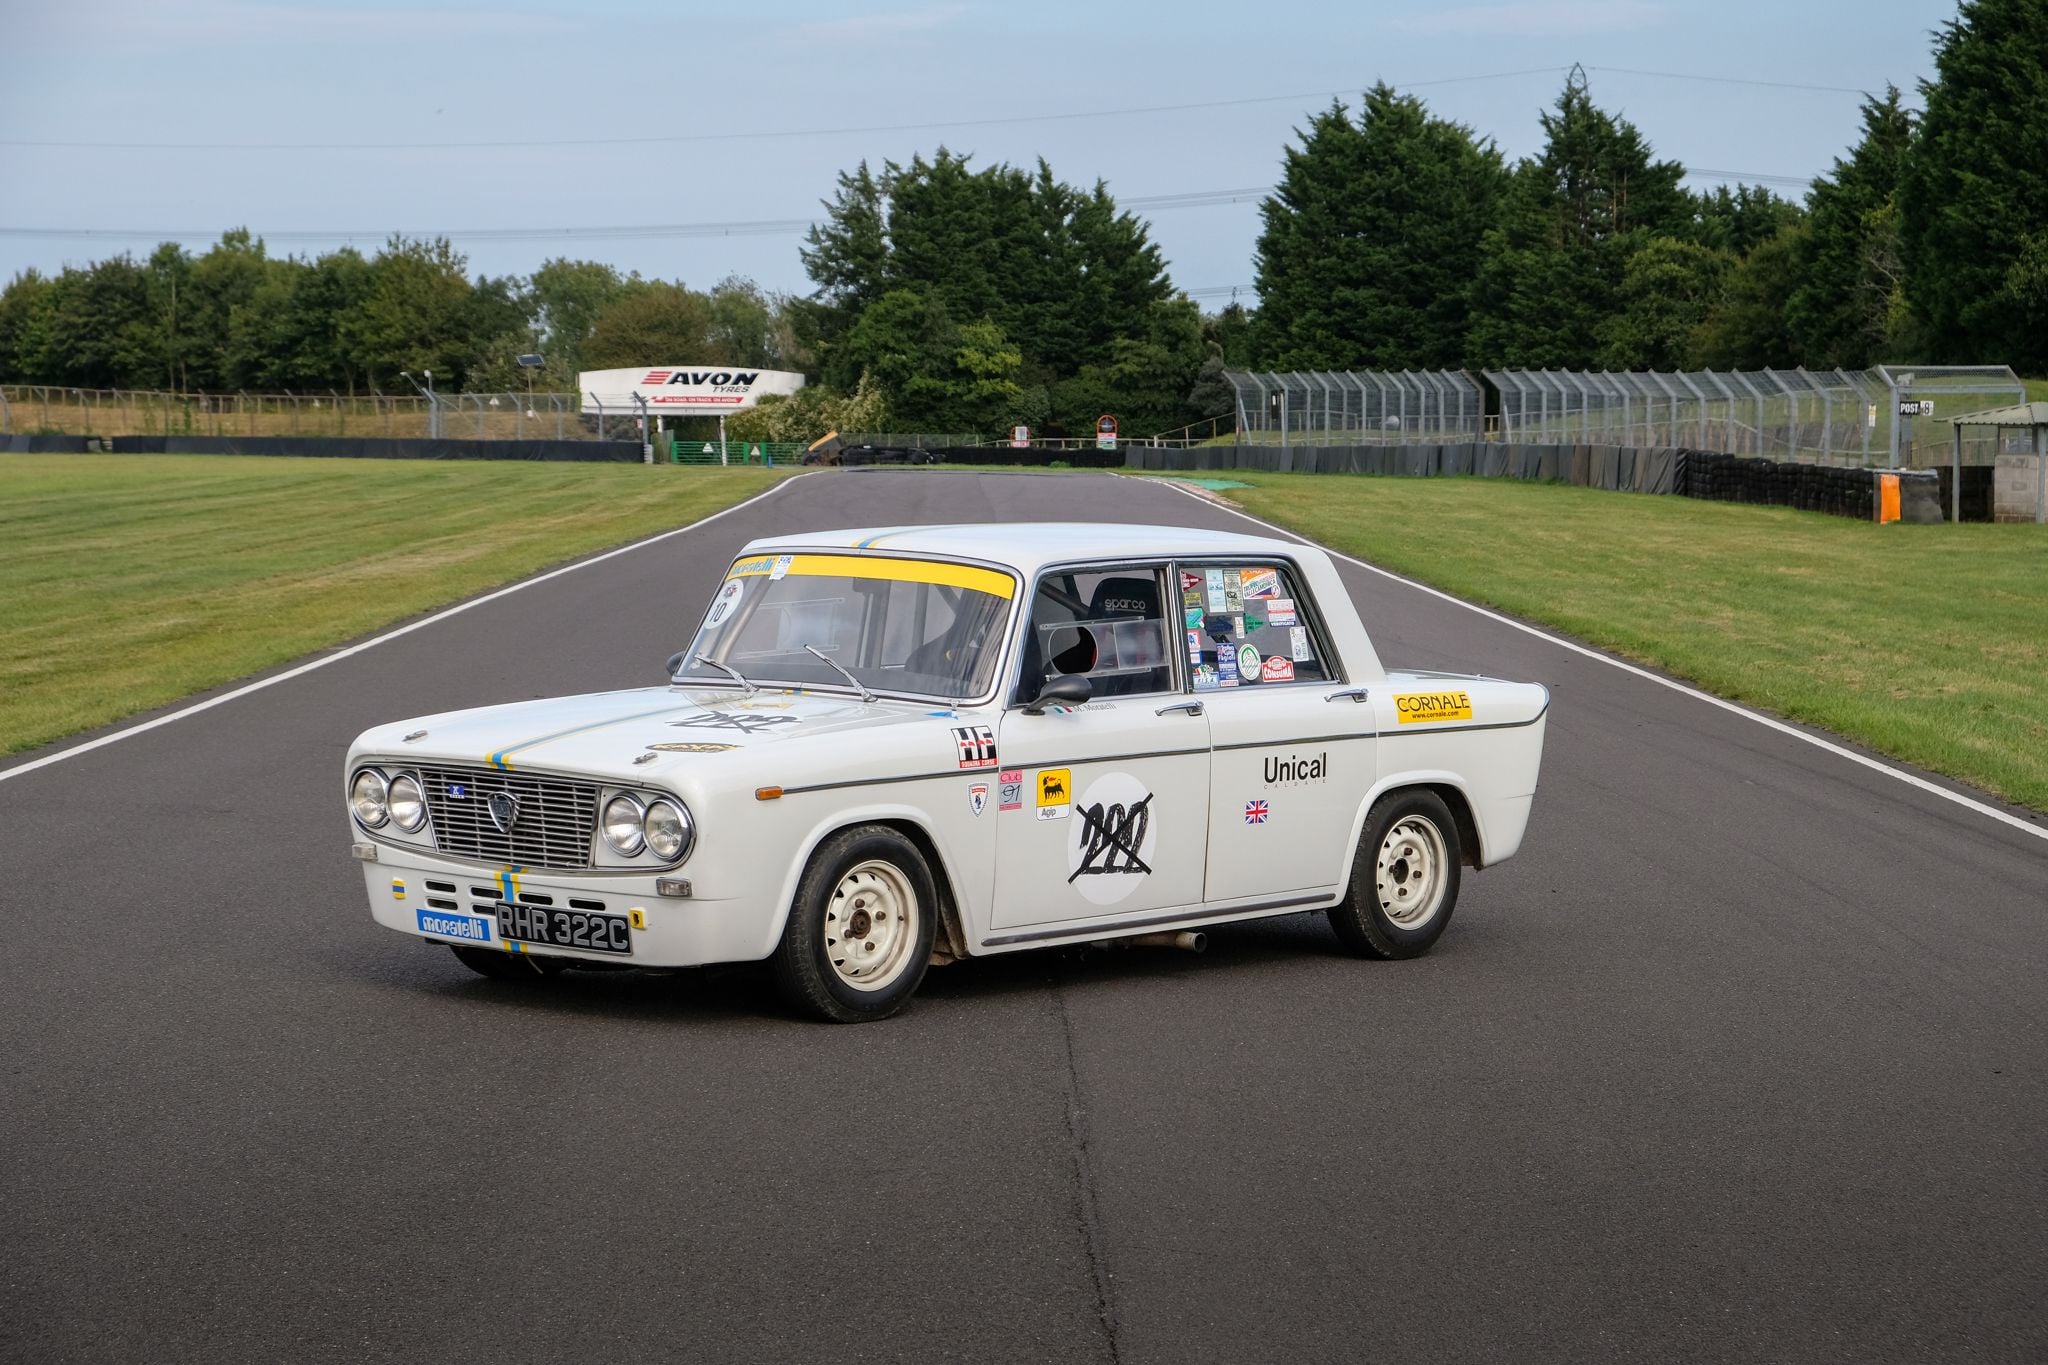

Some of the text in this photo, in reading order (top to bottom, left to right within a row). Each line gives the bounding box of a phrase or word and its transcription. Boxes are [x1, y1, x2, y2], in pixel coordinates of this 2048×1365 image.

[669, 372, 758, 385] AVON
[1900, 402, 1930, 415] POST 8
[709, 602, 728, 622] 10
[1104, 598, 1146, 611] sparco
[1396, 693, 1471, 713] CORNALE
[1411, 710, 1460, 720] www.cornale.com
[952, 726, 996, 761] HF
[1264, 752, 1327, 784] Unical
[1000, 772, 1022, 783] Club
[1263, 779, 1328, 790] CALDAIE
[1001, 784, 1021, 803] 91
[1041, 807, 1057, 818] Agip
[421, 916, 484, 940] moratelli
[496, 903, 629, 951] RHR 322C
